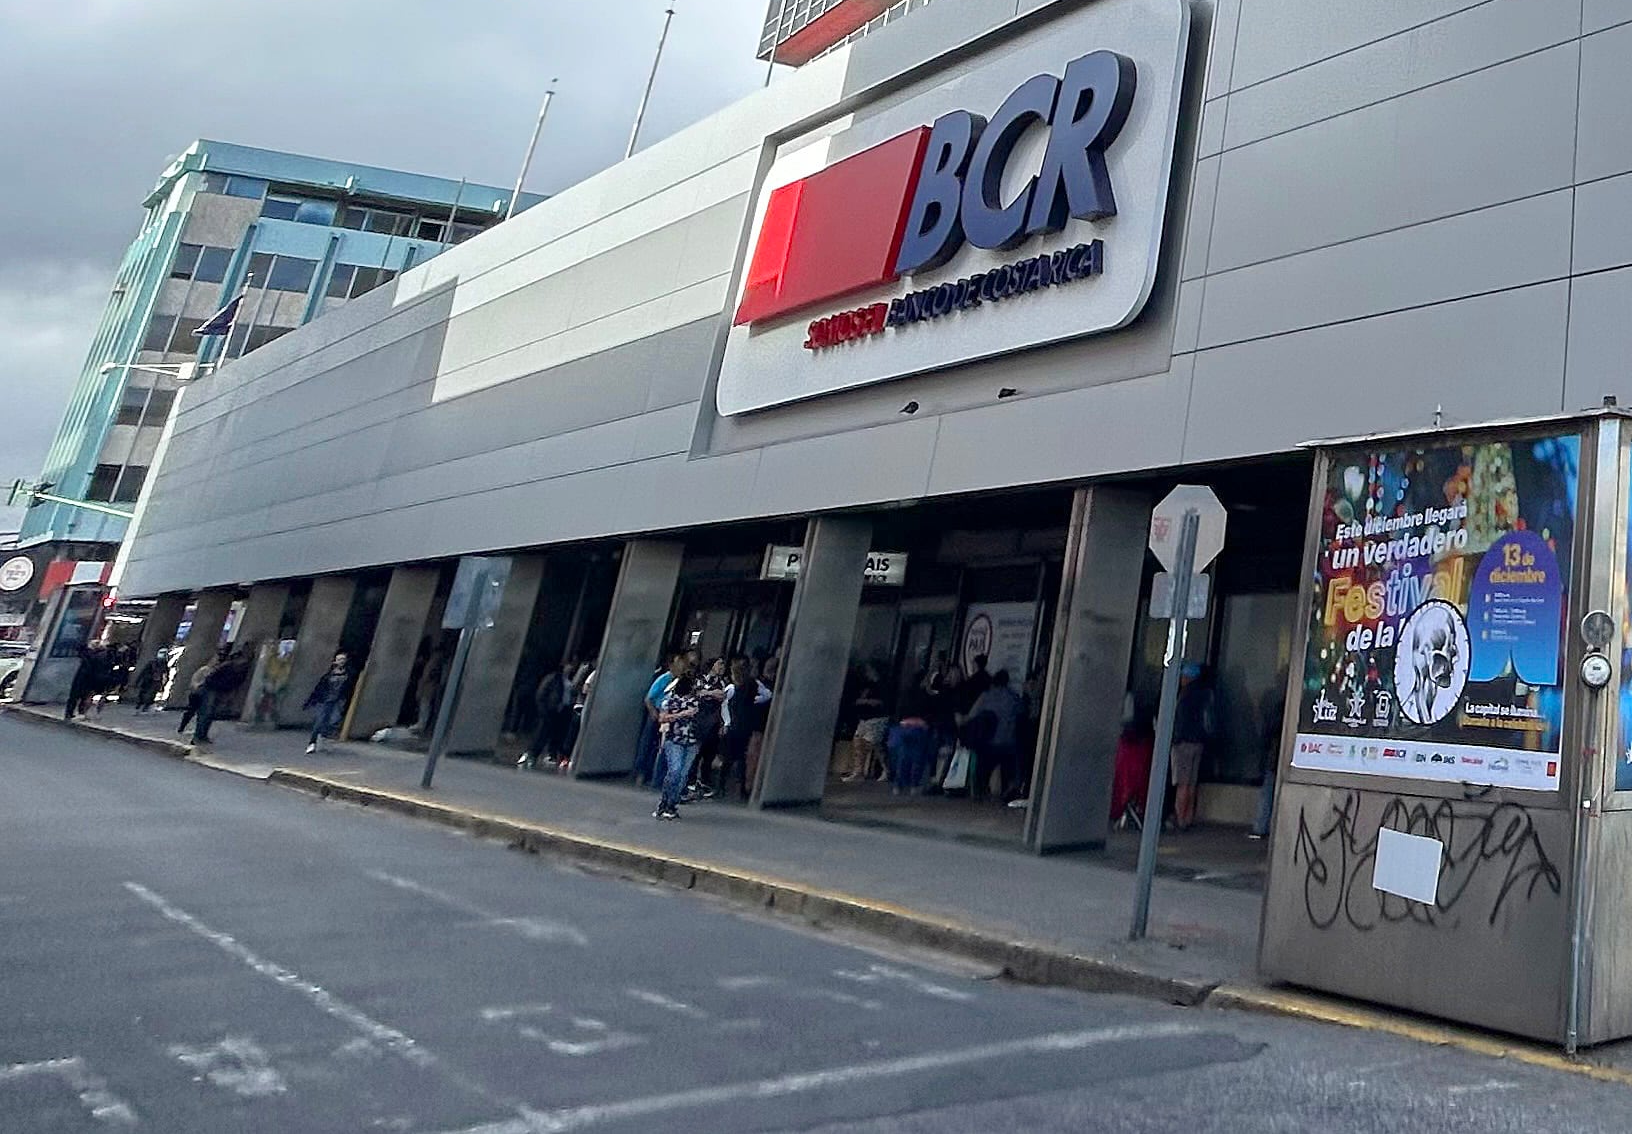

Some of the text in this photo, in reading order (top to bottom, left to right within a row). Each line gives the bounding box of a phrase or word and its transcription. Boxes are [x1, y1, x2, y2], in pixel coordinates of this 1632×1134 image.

[896, 50, 1137, 276] BCR
[979, 254, 1051, 303] COSTA
[1050, 238, 1104, 285] RICA
[1335, 522, 1363, 541] Este
[1364, 511, 1423, 537] diciembre
[1332, 528, 1468, 570] un verdadero
[1503, 543, 1522, 566] 13
[1324, 556, 1465, 628] Festival
[1489, 566, 1547, 584] diciembre
[1345, 624, 1373, 652] de
[1374, 620, 1395, 649] la
